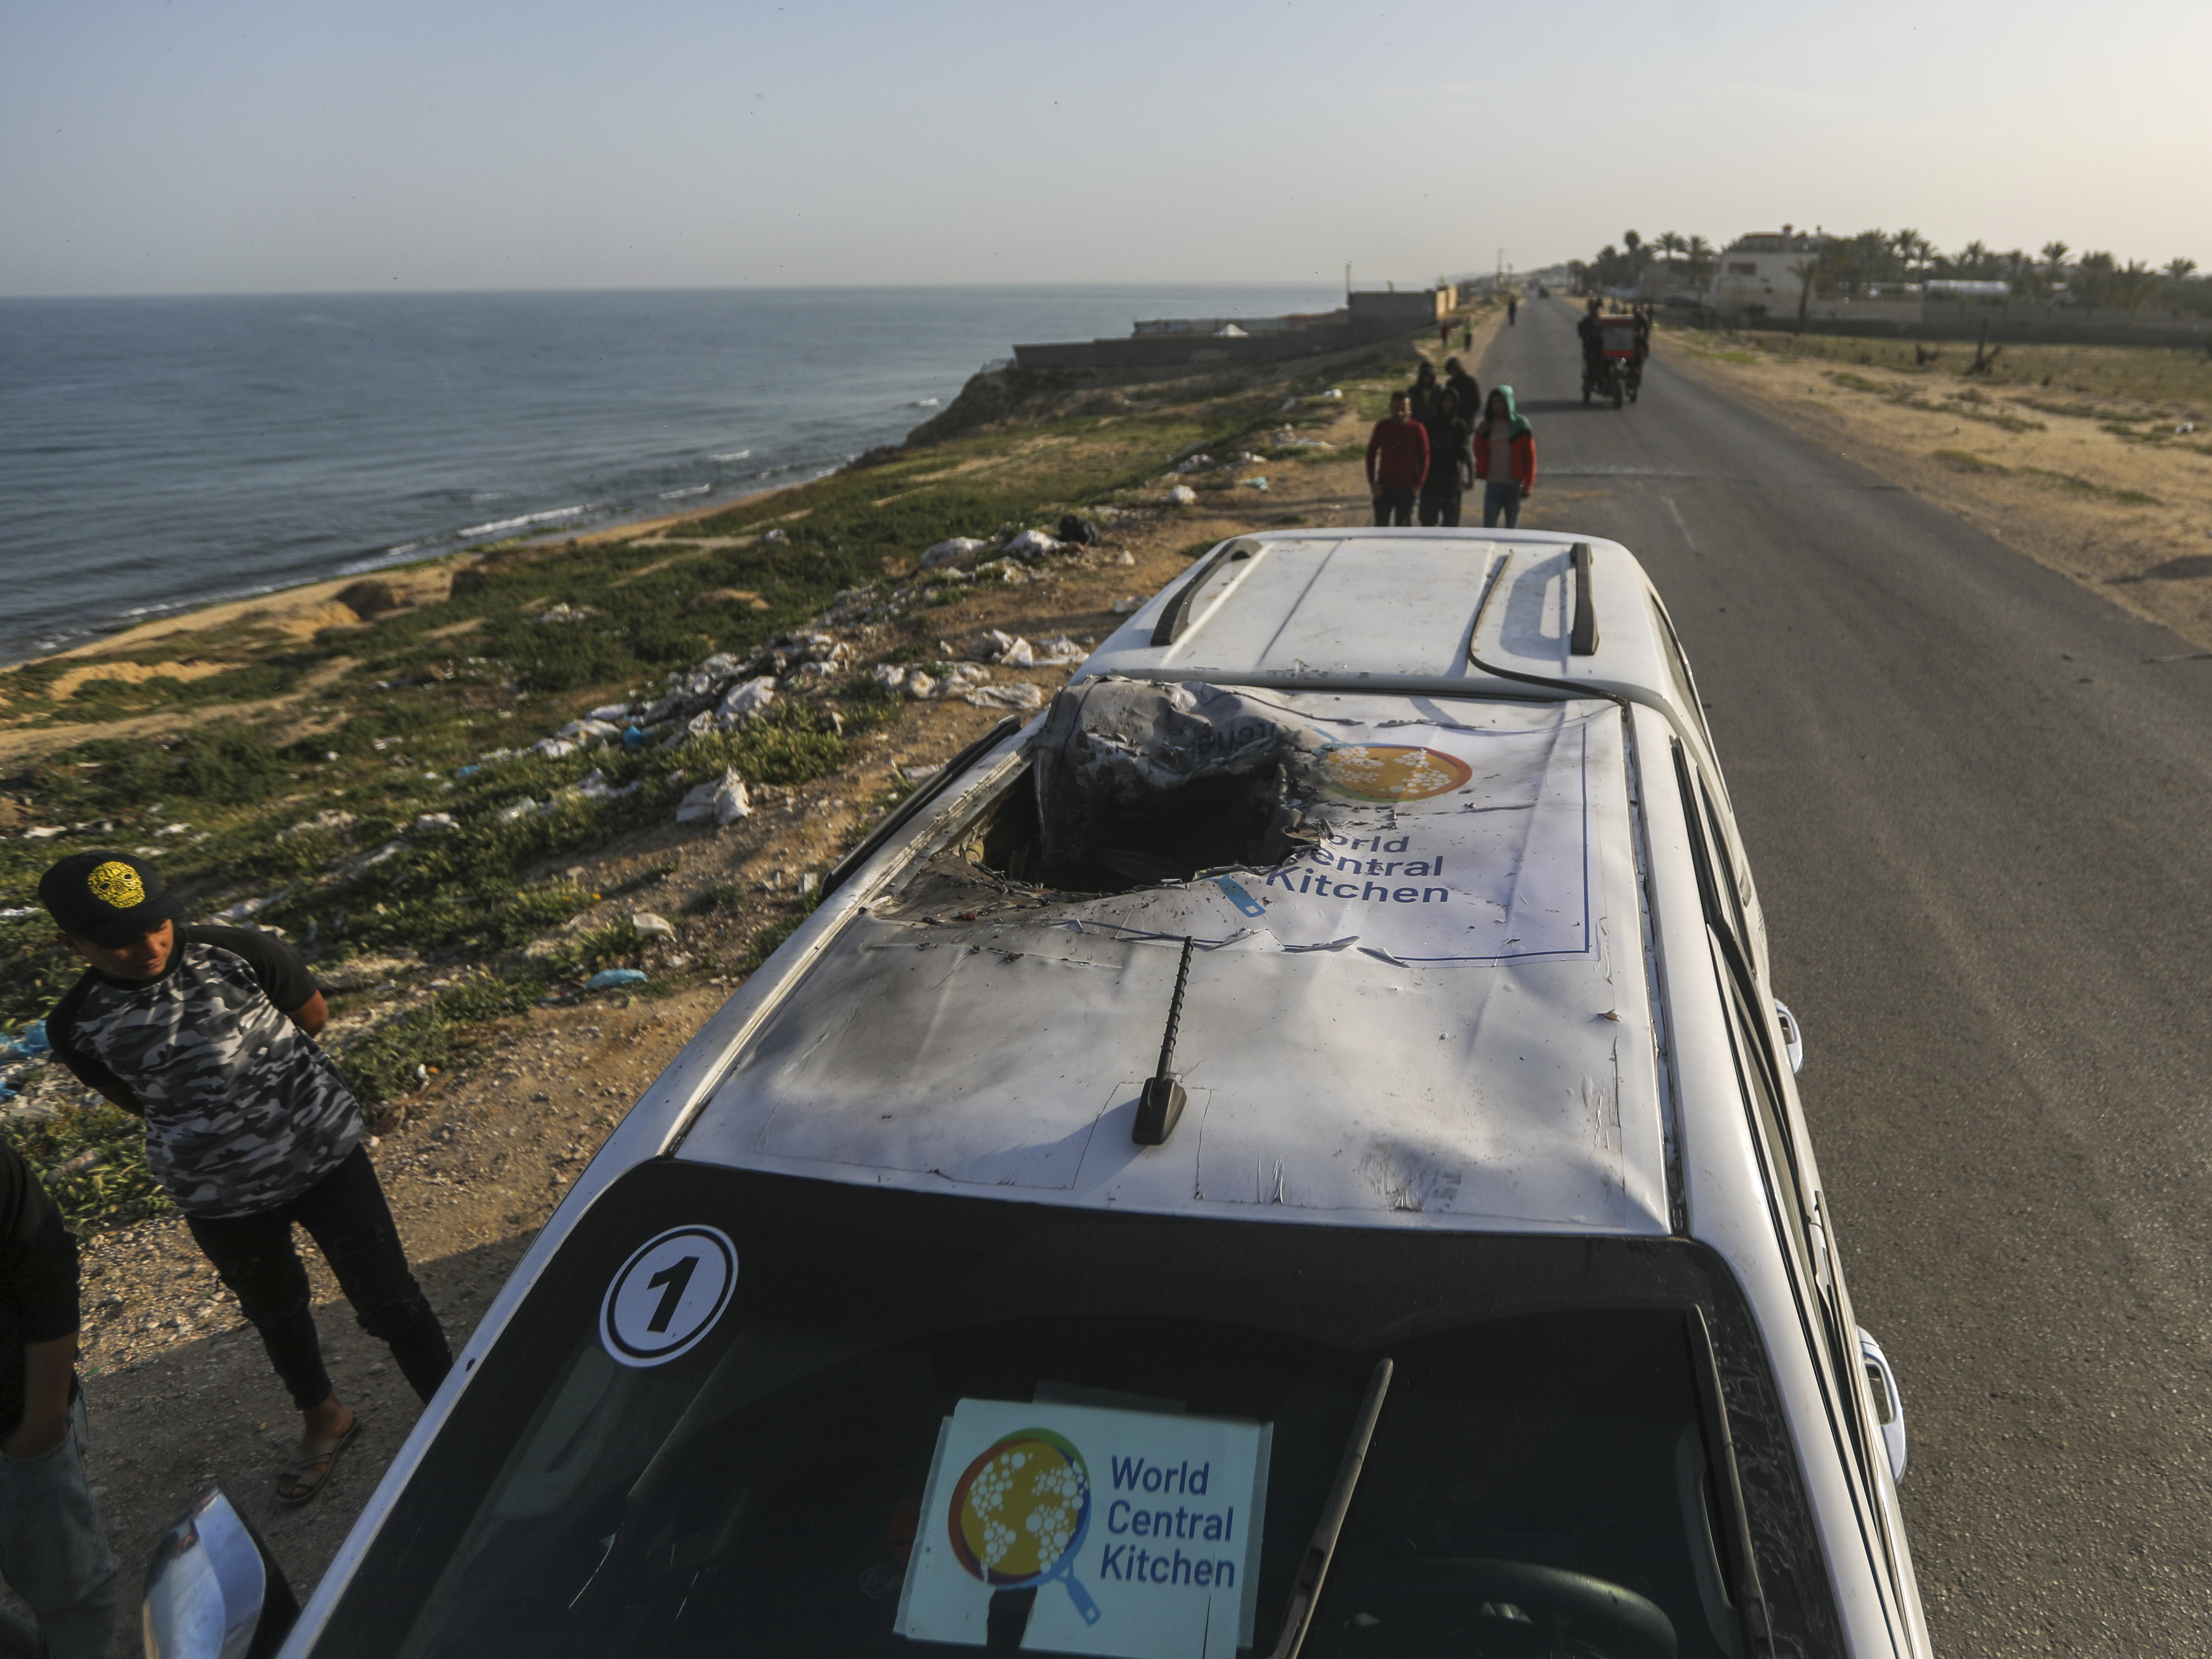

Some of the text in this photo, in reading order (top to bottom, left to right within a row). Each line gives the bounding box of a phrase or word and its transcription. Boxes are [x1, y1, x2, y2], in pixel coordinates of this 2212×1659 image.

[1296, 847, 1444, 877] entral
[1331, 835, 1410, 853] orld
[1265, 865, 1450, 904] Kitchen
[646, 1255, 700, 1333] 1
[1111, 1455, 1210, 1496] World
[1107, 1499, 1234, 1542] Central
[1100, 1543, 1235, 1588] Kitchen
